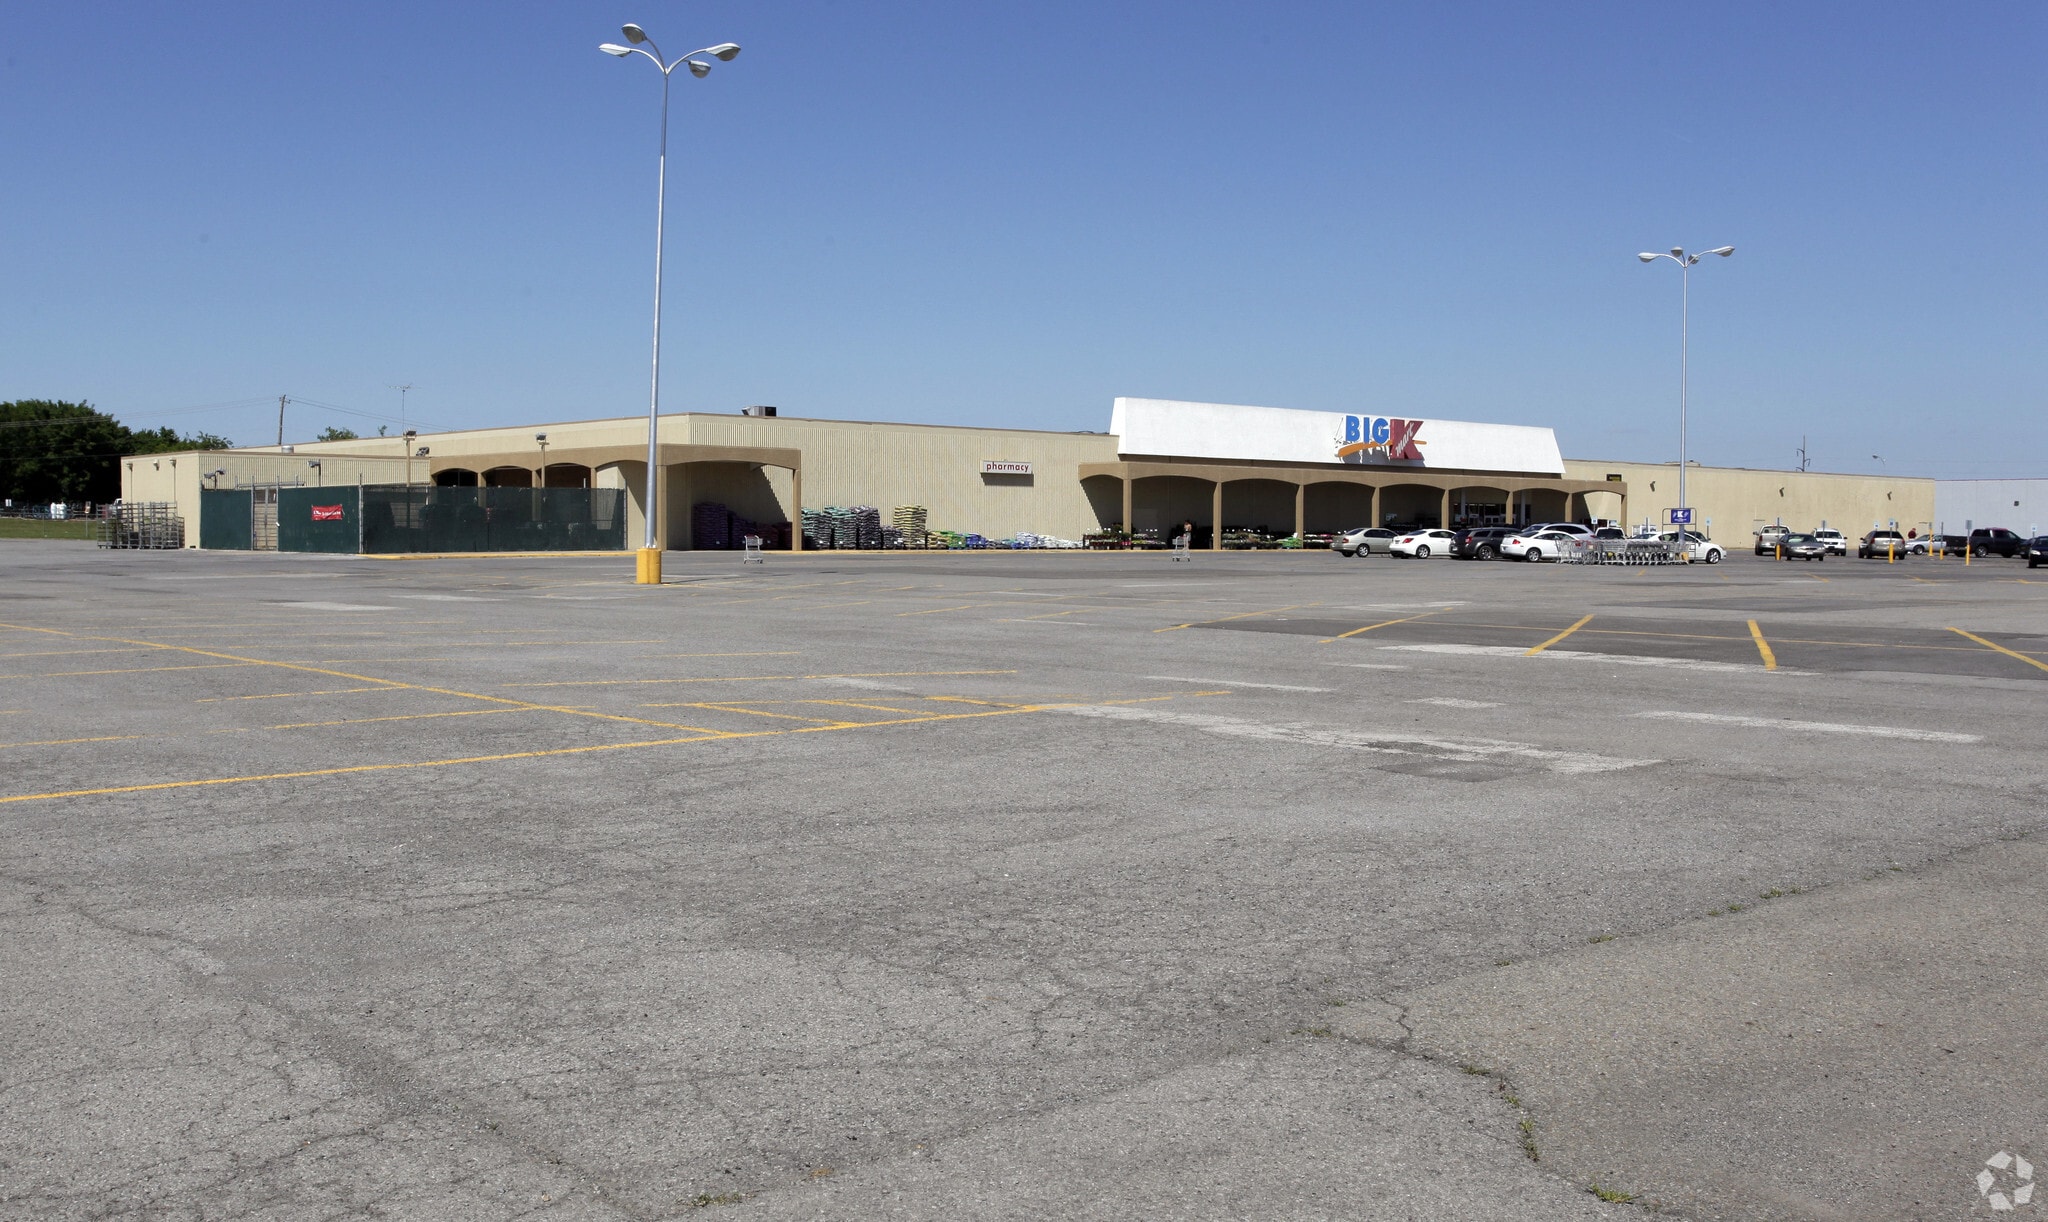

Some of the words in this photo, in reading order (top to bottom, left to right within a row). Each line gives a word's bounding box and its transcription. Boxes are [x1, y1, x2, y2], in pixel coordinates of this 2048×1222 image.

[1345, 415, 1389, 444] BIG
[1389, 419, 1424, 459] K
[986, 461, 1029, 473] pharmacy
